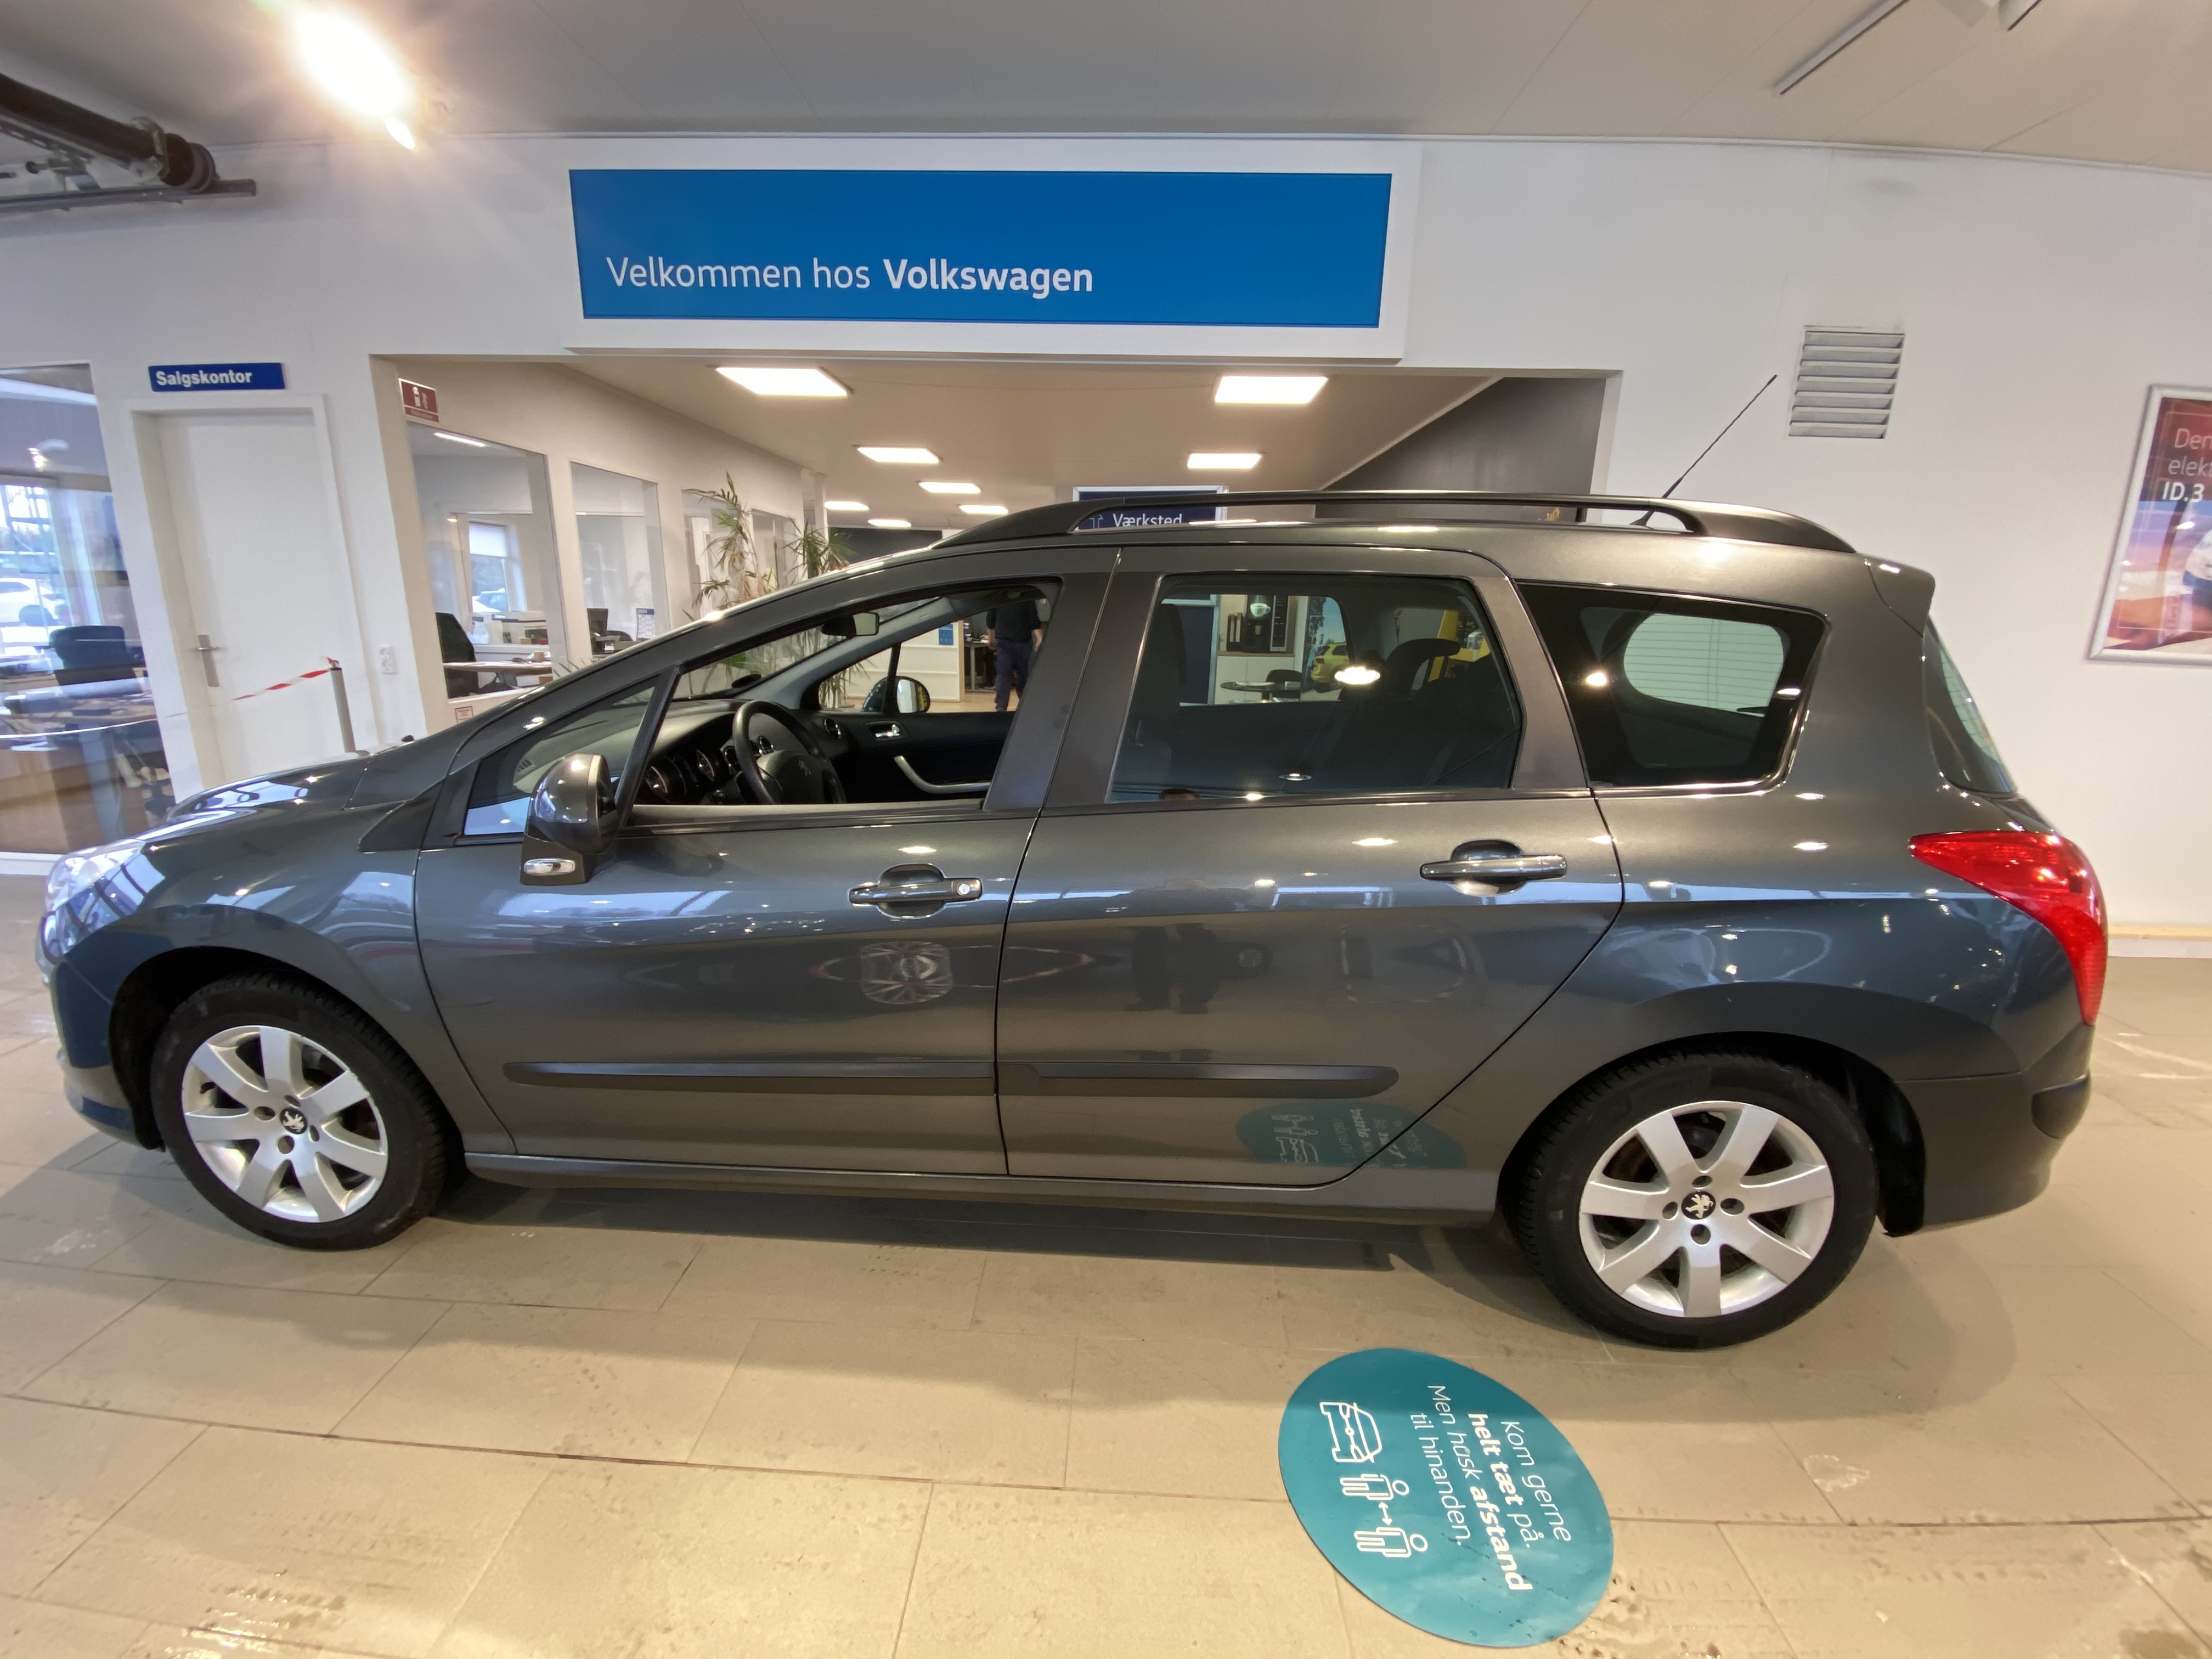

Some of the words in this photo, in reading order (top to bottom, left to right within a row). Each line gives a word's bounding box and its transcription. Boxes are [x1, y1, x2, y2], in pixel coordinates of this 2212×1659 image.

[606, 256, 801, 288] Velkommen
[813, 257, 871, 289] hos
[883, 258, 1093, 300] Volkswagen
[156, 370, 252, 387] Salgskontor
[2174, 428, 2212, 450] Den
[2162, 481, 2204, 503] ID.3
[1113, 513, 1182, 527] Værksted
[1410, 1413, 1435, 1430] til
[1468, 1413, 1502, 1457] helt
[1418, 1437, 1471, 1545] hinanden.
[1427, 1385, 1456, 1424] Men
[1447, 1432, 1483, 1480] husk
[1470, 1486, 1534, 1590] afstand
[1490, 1462, 1524, 1506] tæt
[1500, 1421, 1535, 1466] Kom
[1521, 1475, 1572, 1542] gerne
[1506, 1513, 1545, 1548] på.
